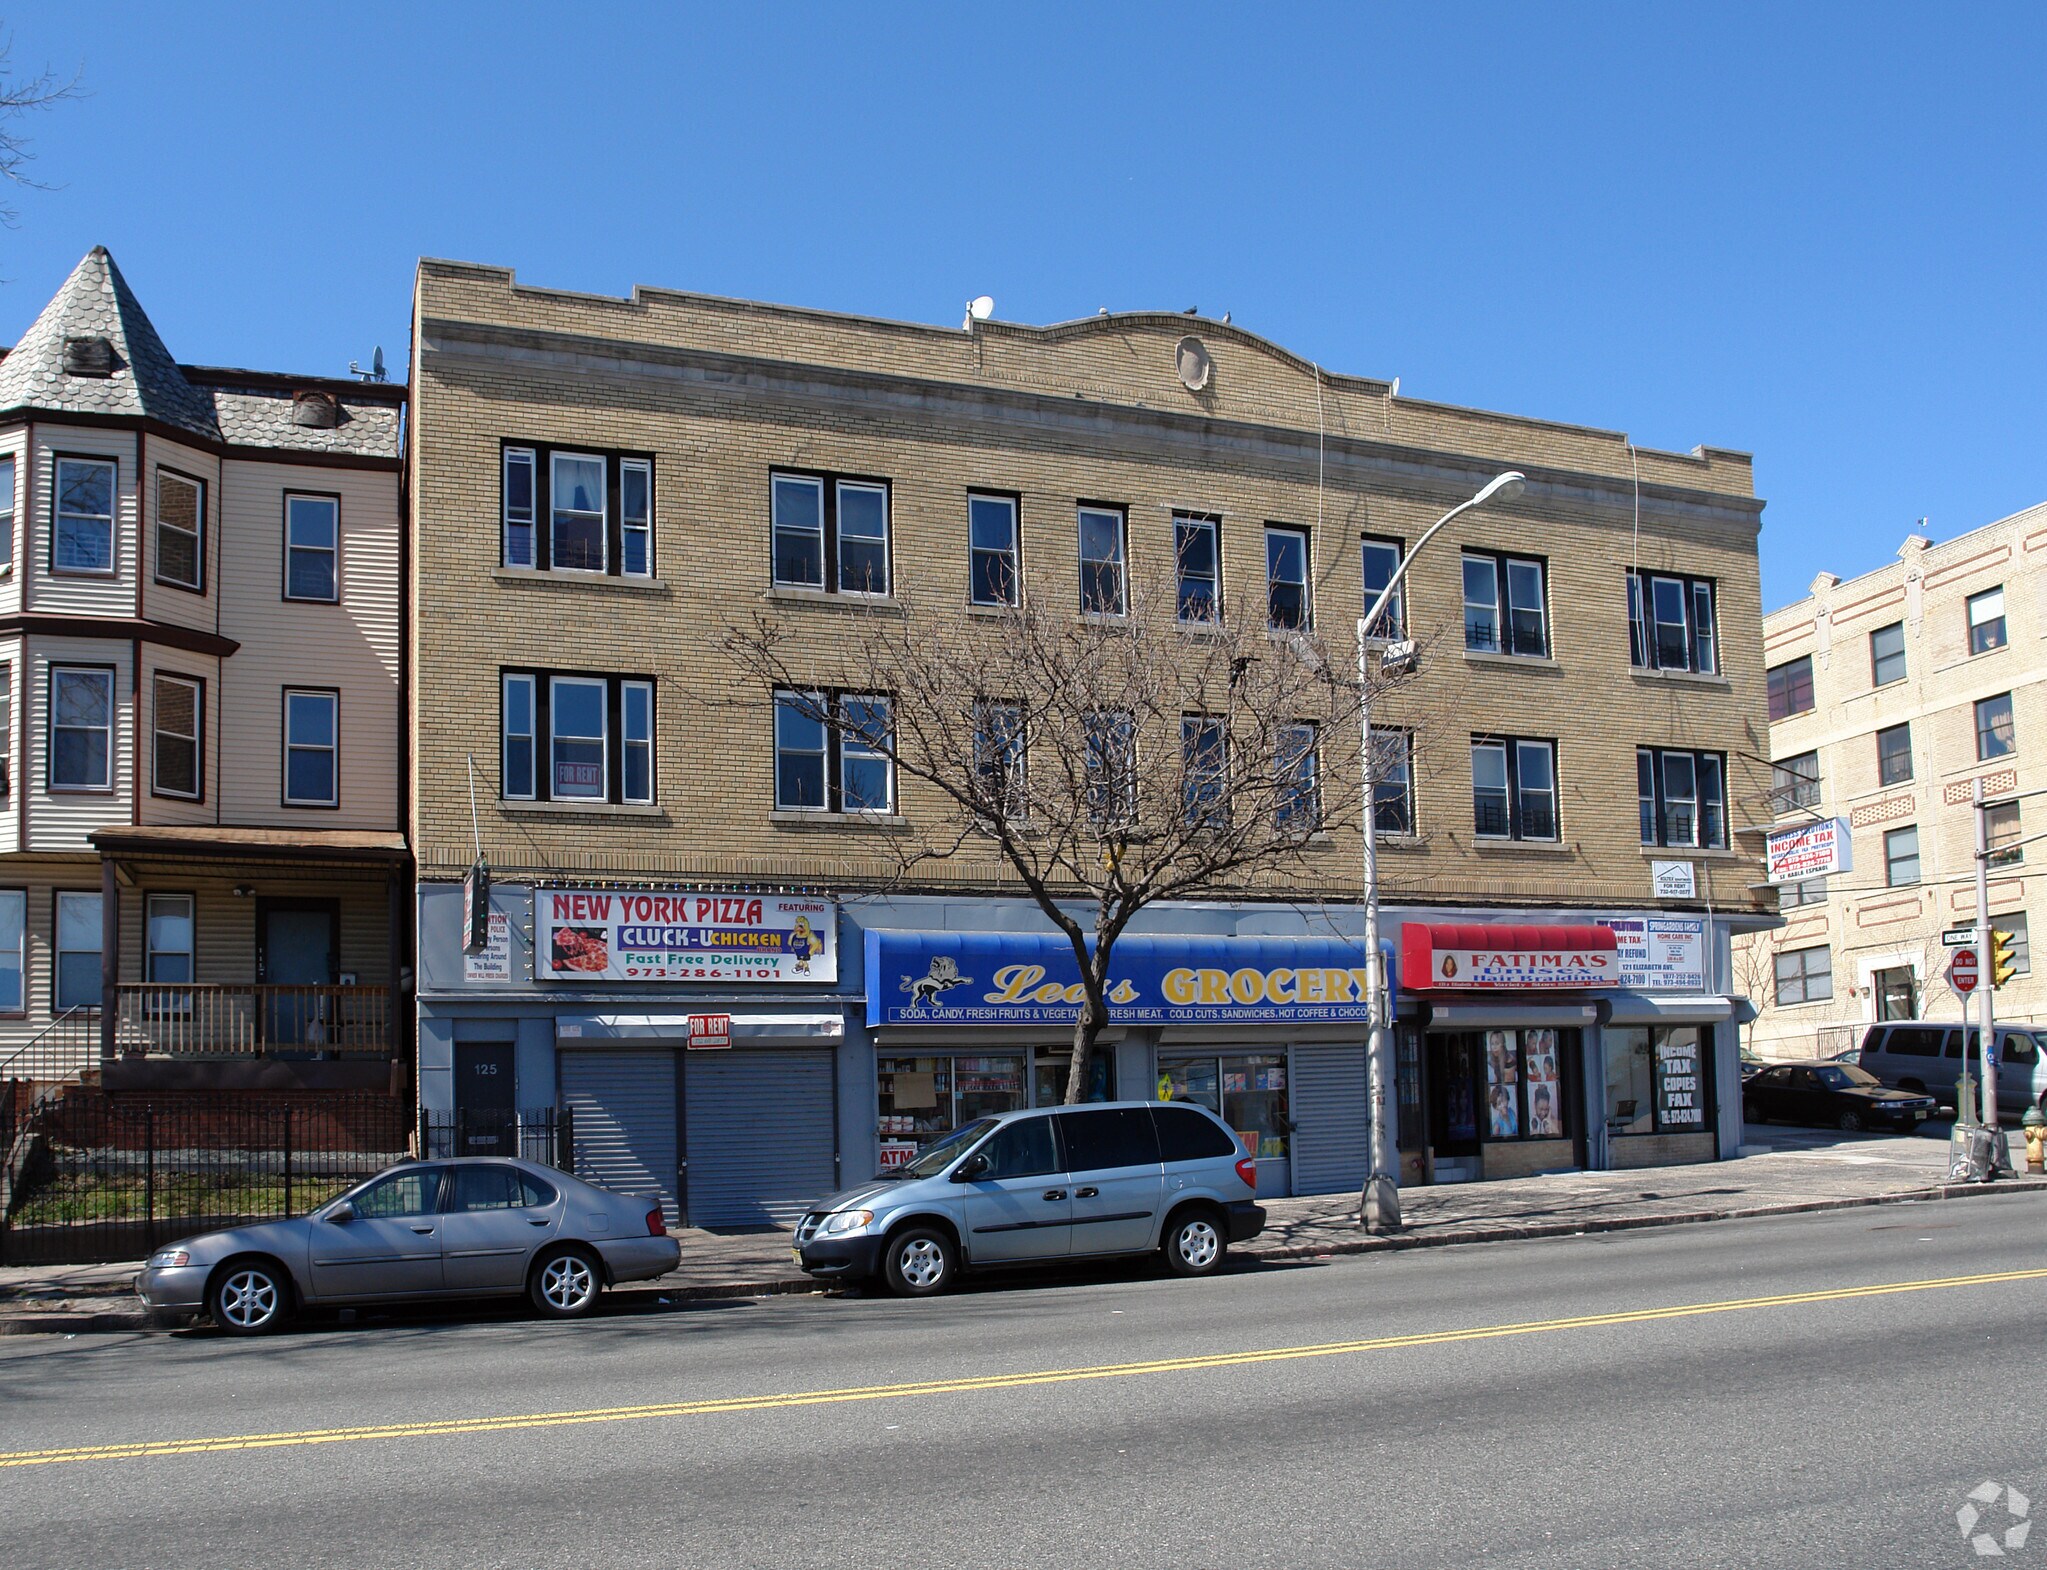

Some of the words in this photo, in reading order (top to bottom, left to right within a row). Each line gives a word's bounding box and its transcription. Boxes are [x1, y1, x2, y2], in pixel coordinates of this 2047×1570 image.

[560, 766, 575, 783] FOR
[577, 767, 598, 784] RENT
[1771, 836, 1811, 853] INCOME
[1814, 831, 1834, 843] TAX
[553, 894, 612, 921] NEW
[619, 895, 689, 925] YORK
[696, 898, 763, 926] PIZZA
[778, 903, 825, 912] FEATURING
[1629, 935, 1641, 943] TAX
[626, 953, 661, 965] Fast
[667, 954, 704, 965] Free
[711, 954, 779, 967] Delivery
[1625, 949, 1646, 958] REFUND
[1471, 954, 1608, 967] FATIMA'S
[626, 968, 781, 978] 973-286-1101
[1957, 976, 1974, 984] ENTER
[900, 1009, 929, 1019] SODA,
[932, 1009, 964, 1019] CANDY,
[966, 1009, 996, 1019] FRESH
[999, 1009, 1030, 1019] FRUITS
[1033, 1009, 1040, 1019] &
[1169, 1009, 1193, 1019] COLD
[1280, 1008, 1295, 1018] HOT
[1297, 1008, 1329, 1018] COFFEE
[1330, 1008, 1336, 1017] &
[690, 1018, 705, 1035] FOR
[707, 1017, 729, 1035] RENT
[1660, 1043, 1697, 1060] INCOME
[474, 1064, 497, 1075] 125
[1664, 1059, 1691, 1074] TAX
[1664, 1077, 1696, 1091] COPIES
[1668, 1093, 1693, 1107] FAX
[880, 1151, 913, 1164] ATM
